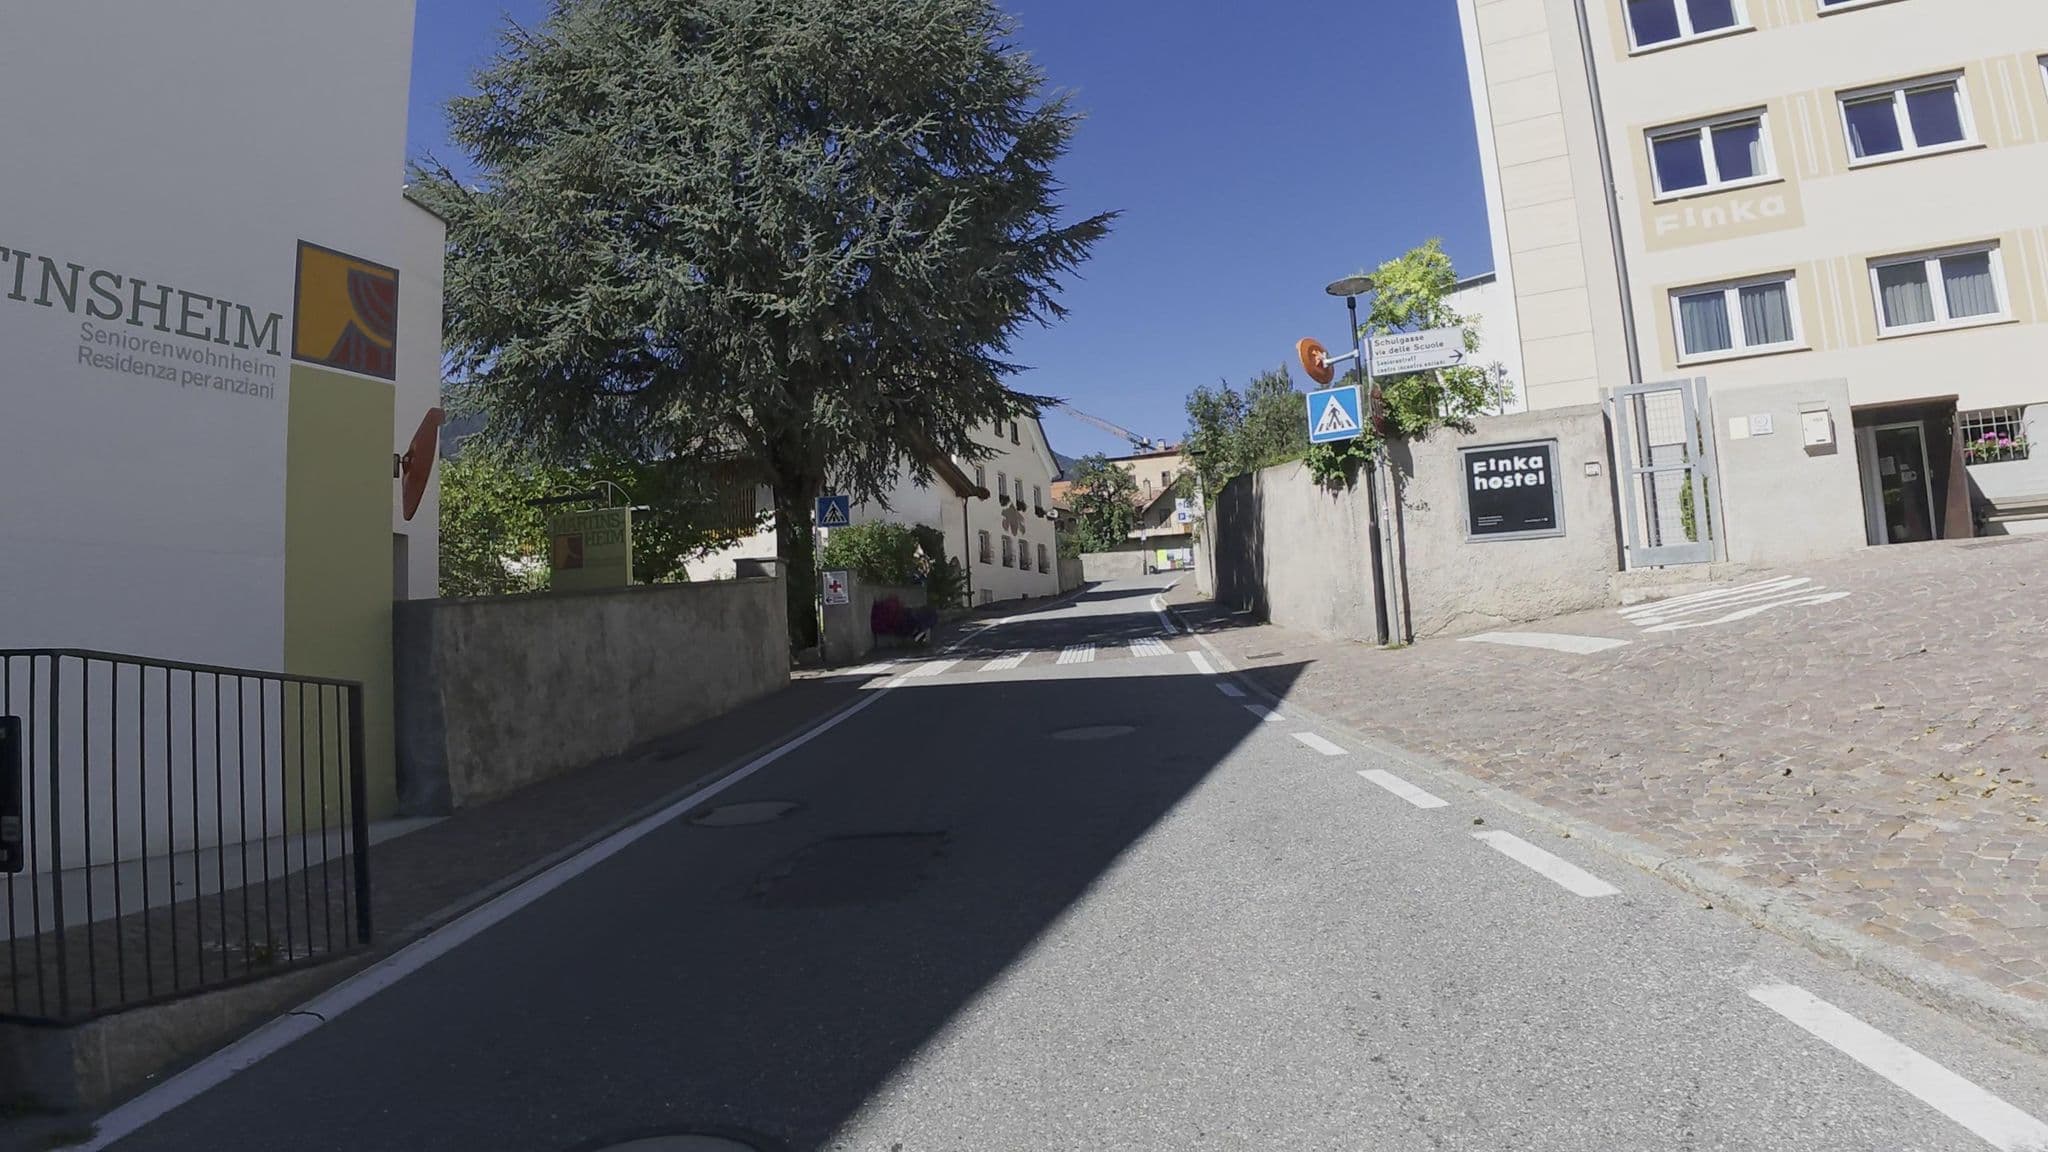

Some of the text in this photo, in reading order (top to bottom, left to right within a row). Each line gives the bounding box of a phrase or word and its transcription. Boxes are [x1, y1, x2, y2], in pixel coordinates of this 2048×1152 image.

[1654, 195, 1786, 236] Finka
[79, 321, 277, 379] Seniorenwohnheim
[1374, 335, 1425, 347] Schulgasse
[1414, 341, 1444, 351] Scuole
[77, 346, 178, 382] Residenza
[1472, 455, 1544, 475] Finka
[1474, 470, 1545, 491] hostel
